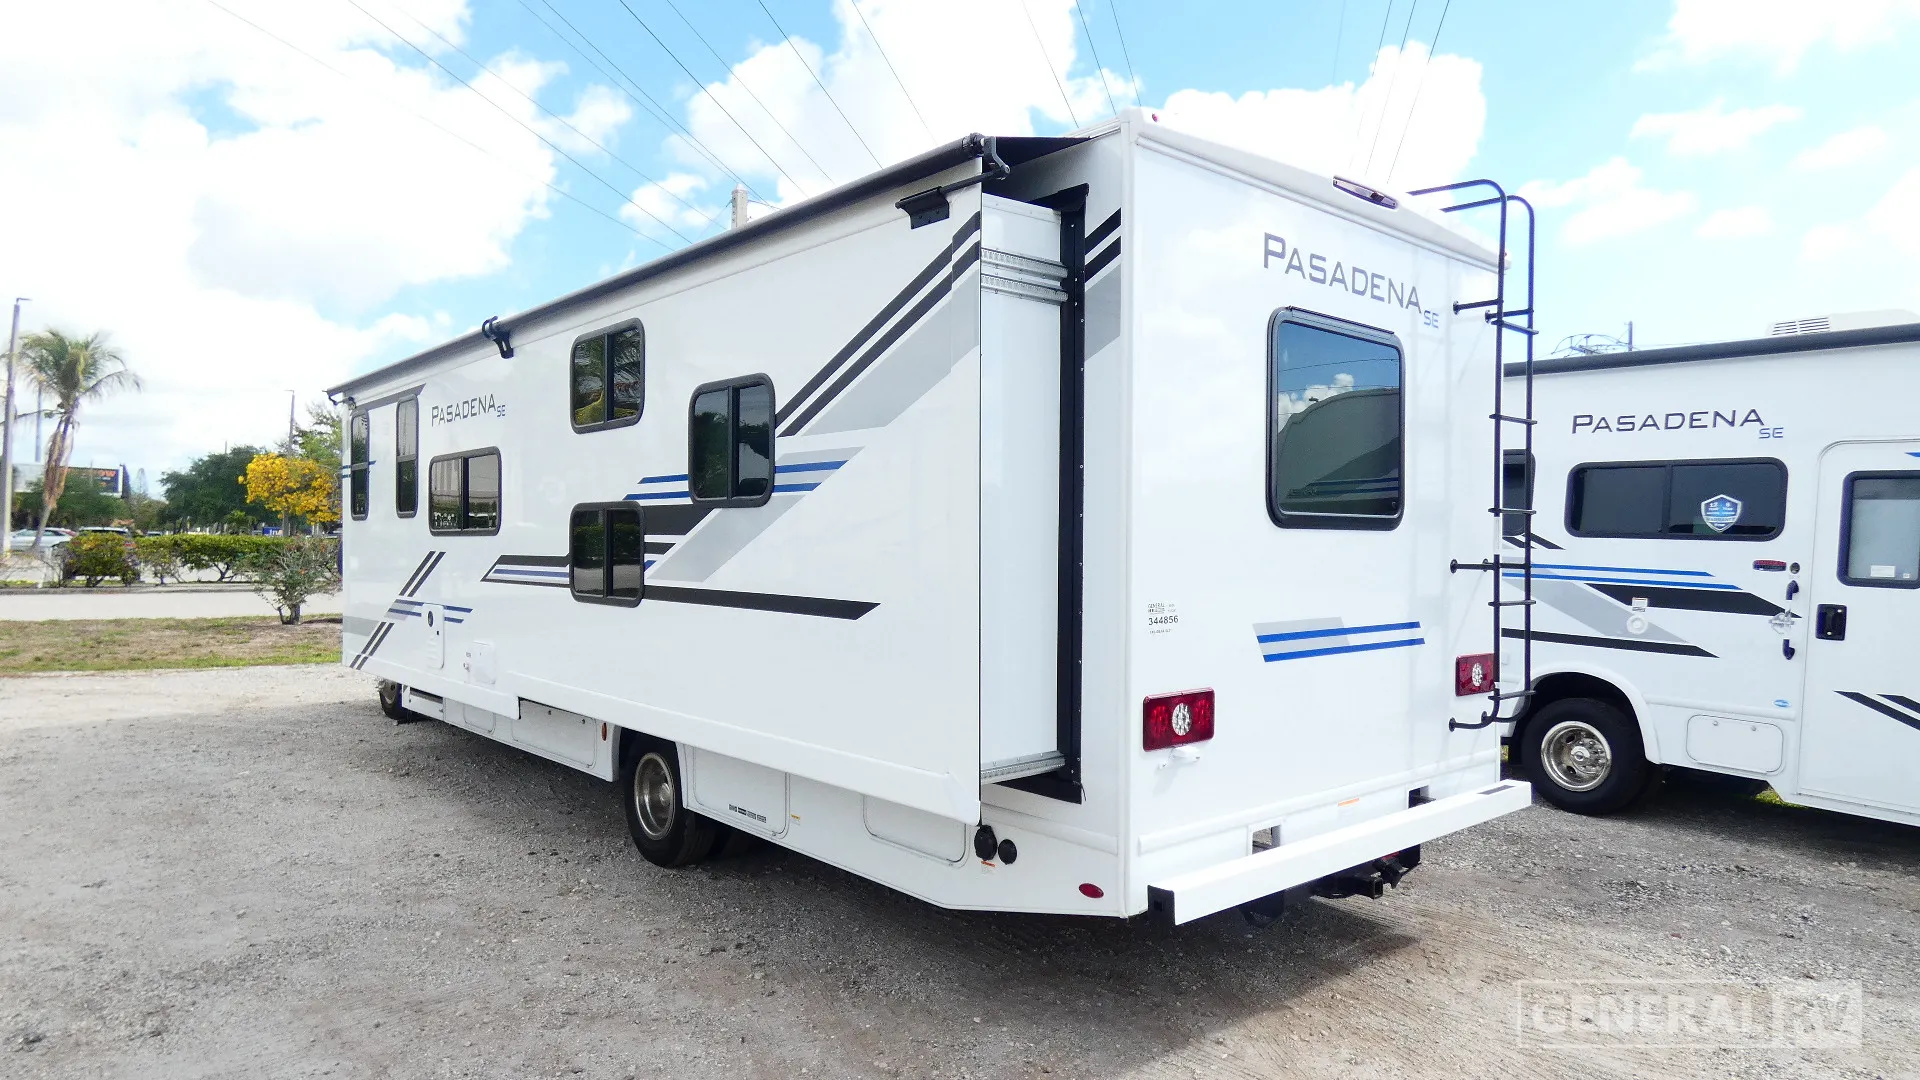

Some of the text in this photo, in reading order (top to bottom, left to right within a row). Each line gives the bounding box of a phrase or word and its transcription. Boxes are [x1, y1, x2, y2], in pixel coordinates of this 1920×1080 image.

[1263, 231, 1440, 329] PASADENA SE
[431, 393, 506, 427] PASADENA SE
[1571, 408, 1784, 439] PASADENA SE
[1148, 615, 1179, 626] 344856
